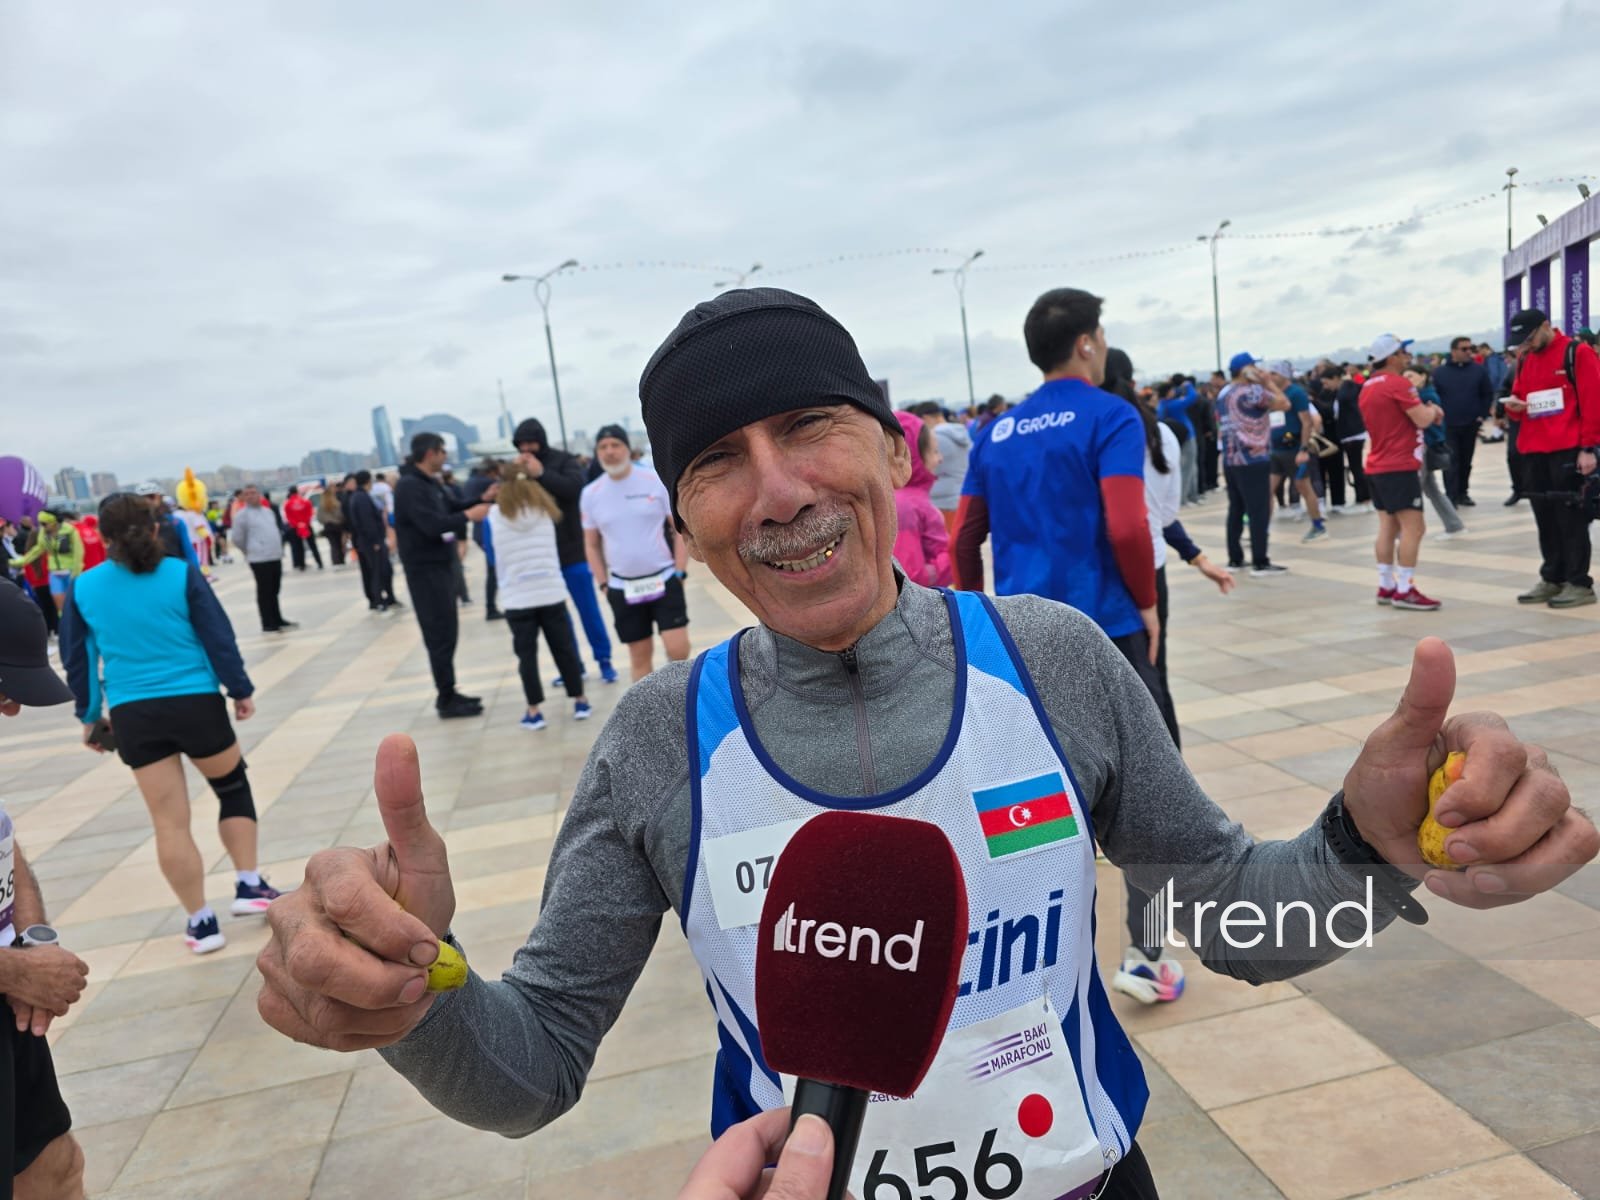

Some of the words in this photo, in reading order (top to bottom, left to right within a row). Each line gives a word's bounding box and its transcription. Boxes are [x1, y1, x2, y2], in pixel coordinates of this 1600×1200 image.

[1016, 411, 1076, 435] GROUP
[736, 855, 774, 893] 07
[774, 902, 924, 972] trend
[1024, 1022, 1047, 1042] BAKI
[991, 1037, 1051, 1072] MARAFONU
[863, 1128, 1023, 1200] 656
